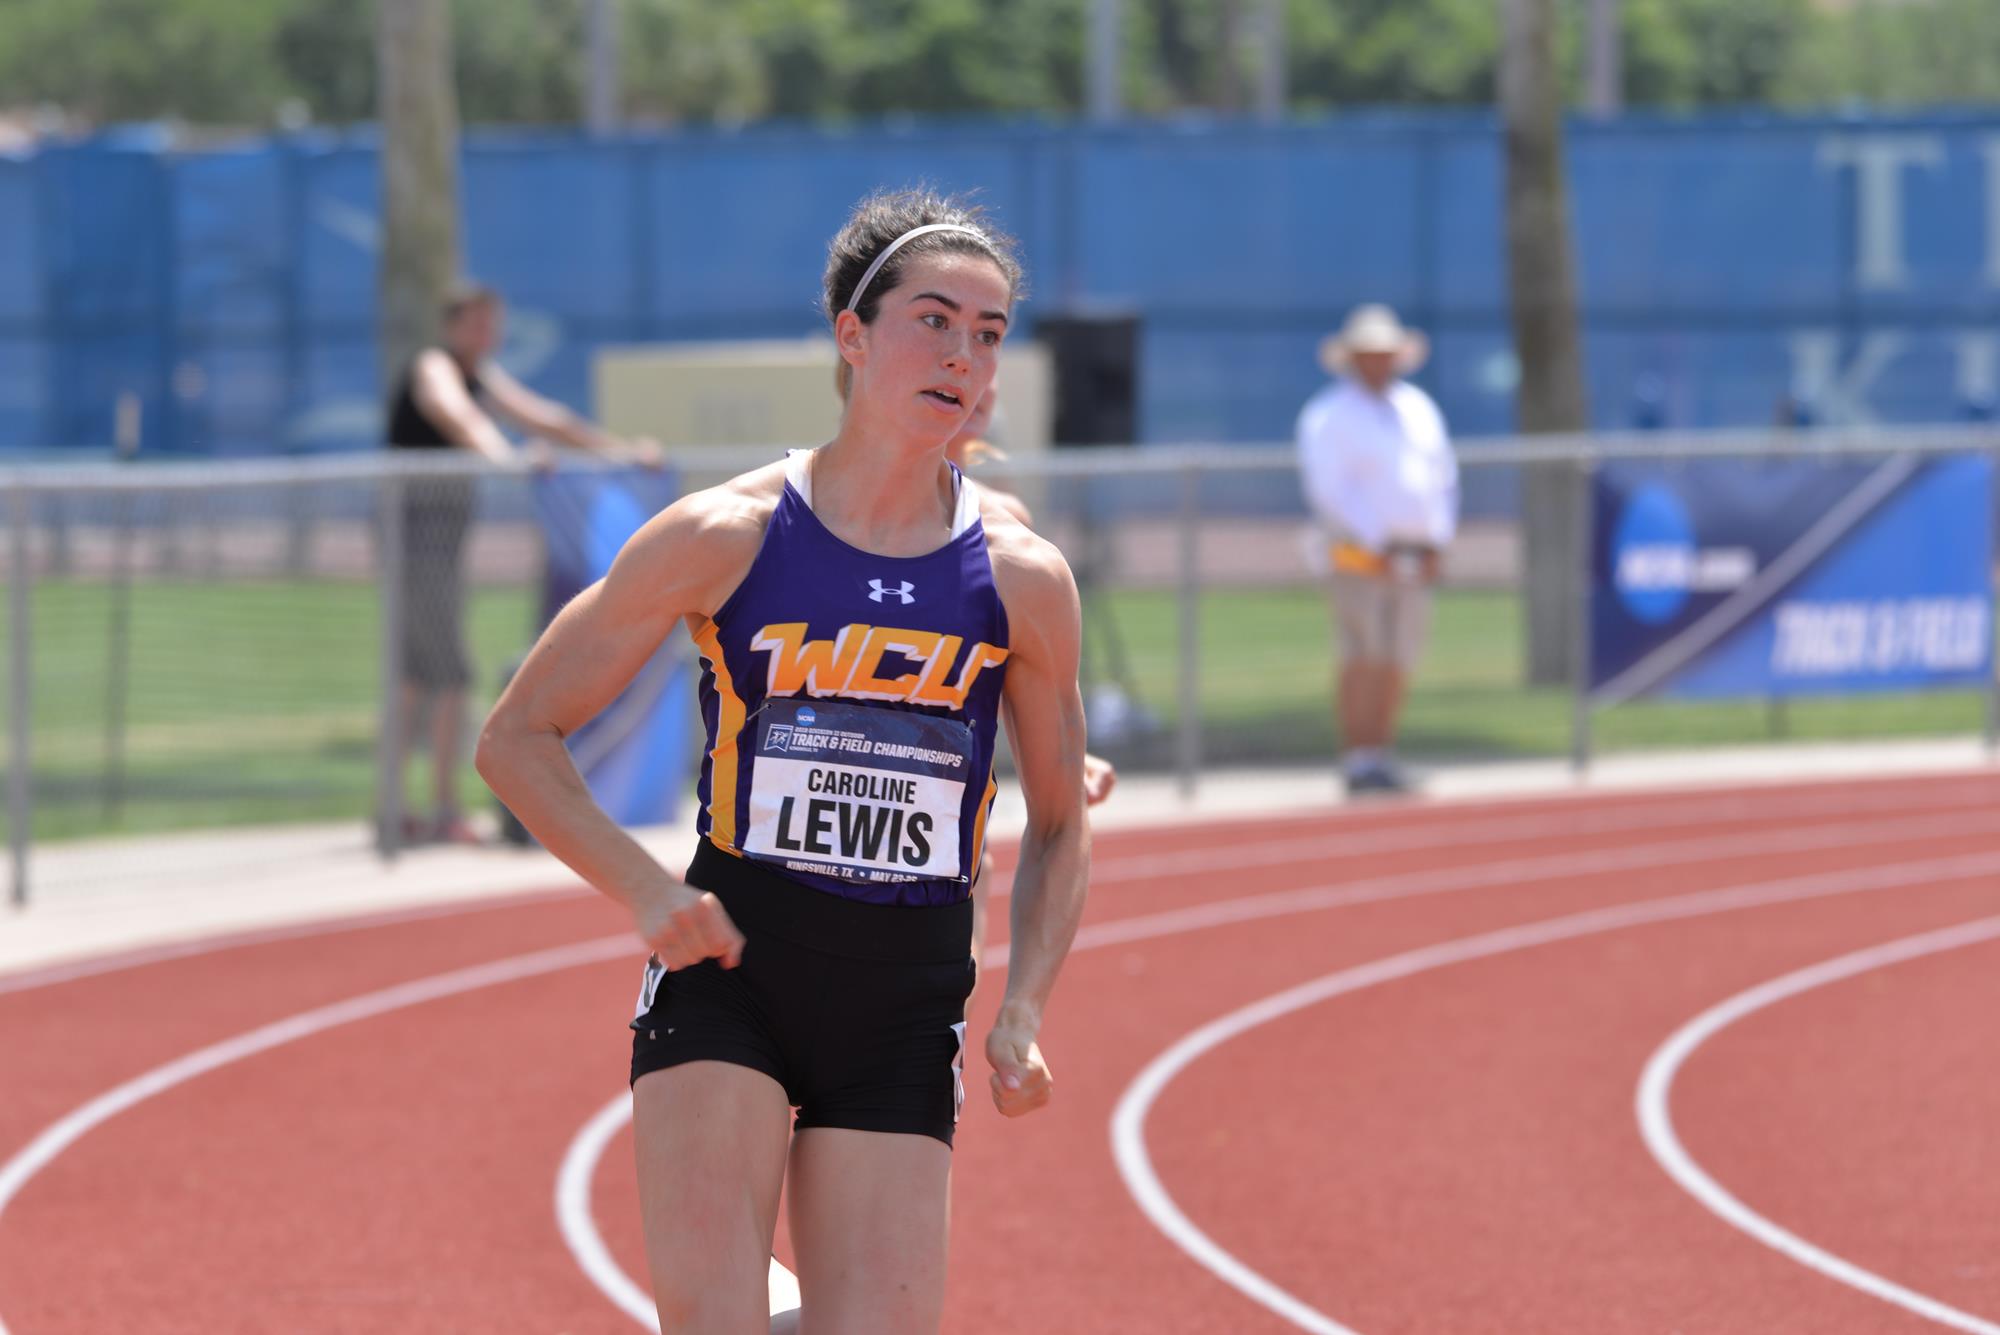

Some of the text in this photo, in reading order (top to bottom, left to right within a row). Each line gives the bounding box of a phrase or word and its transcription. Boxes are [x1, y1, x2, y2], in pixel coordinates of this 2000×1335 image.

[750, 622, 1008, 711] WCU
[791, 732, 829, 749] TRACK
[828, 736, 840, 750] &
[838, 737, 872, 754] FIELD
[873, 741, 964, 769] CHAMPIONSHIPS
[807, 768, 917, 805] CAROLINE
[775, 796, 934, 868] LEWIS
[841, 866, 855, 878] TX
[869, 870, 892, 883] MAY
